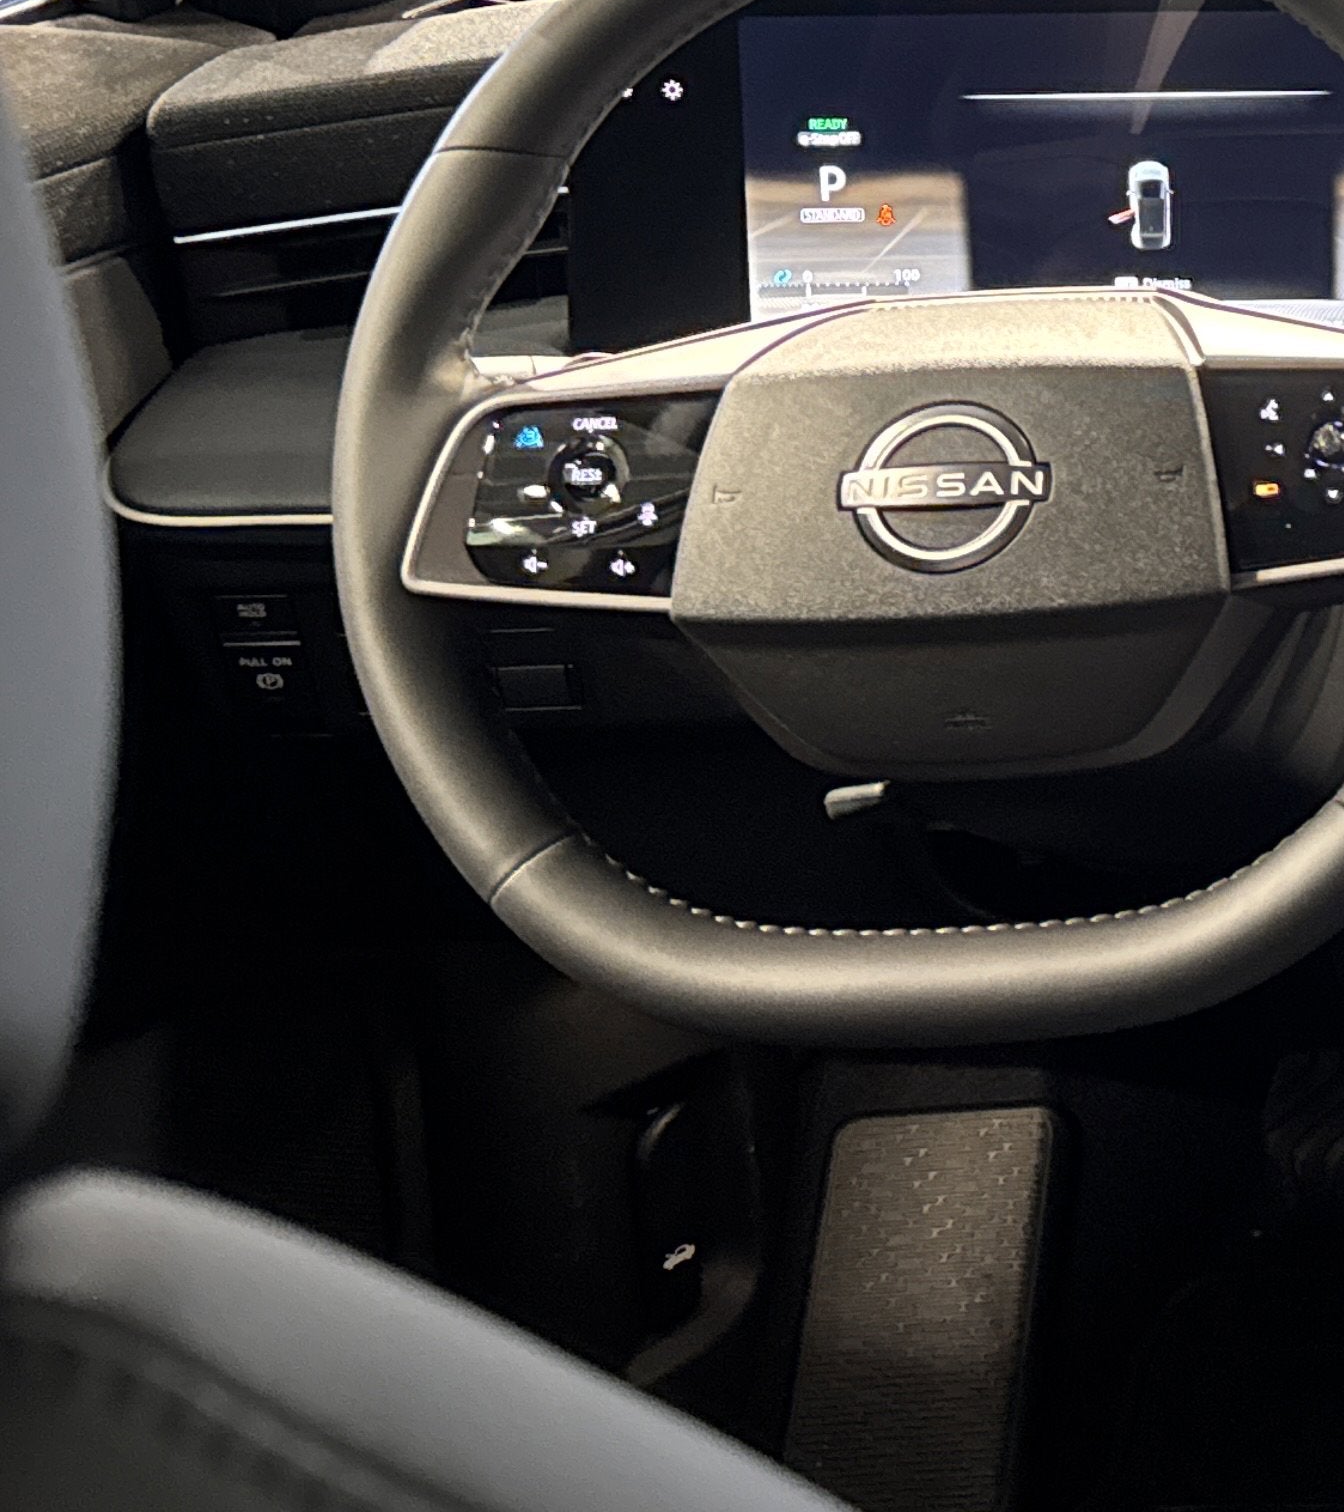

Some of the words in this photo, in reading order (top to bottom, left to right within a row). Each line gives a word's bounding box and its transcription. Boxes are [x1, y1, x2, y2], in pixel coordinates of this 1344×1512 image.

[808, 118, 848, 130] READY
[819, 165, 847, 202] P
[894, 268, 921, 282] 100
[571, 416, 618, 432] CANCEL
[846, 470, 1044, 502] NISSAN
